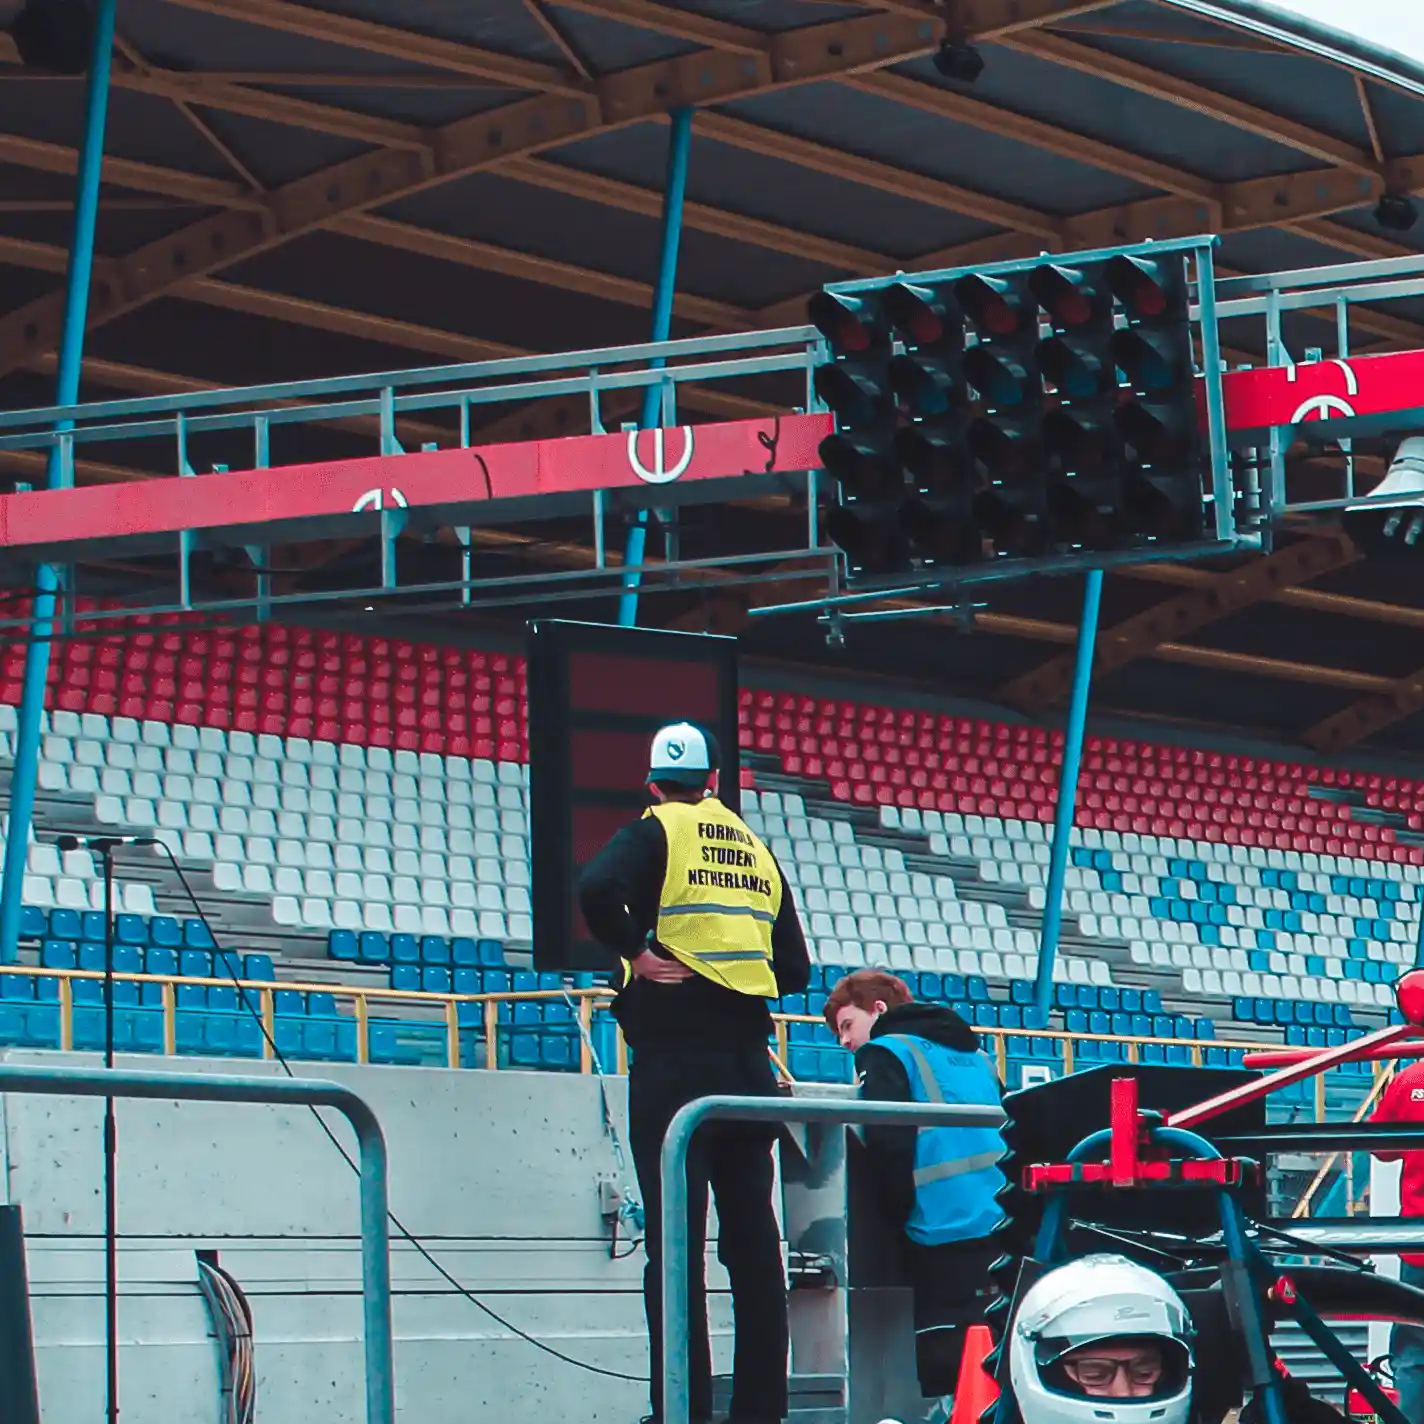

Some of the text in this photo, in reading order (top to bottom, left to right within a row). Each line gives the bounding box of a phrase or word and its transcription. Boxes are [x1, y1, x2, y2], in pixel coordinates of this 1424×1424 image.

[698, 822, 755, 848] FORMULA
[701, 845, 757, 868] STUDENT
[688, 869, 772, 897] NETHERLANDS
